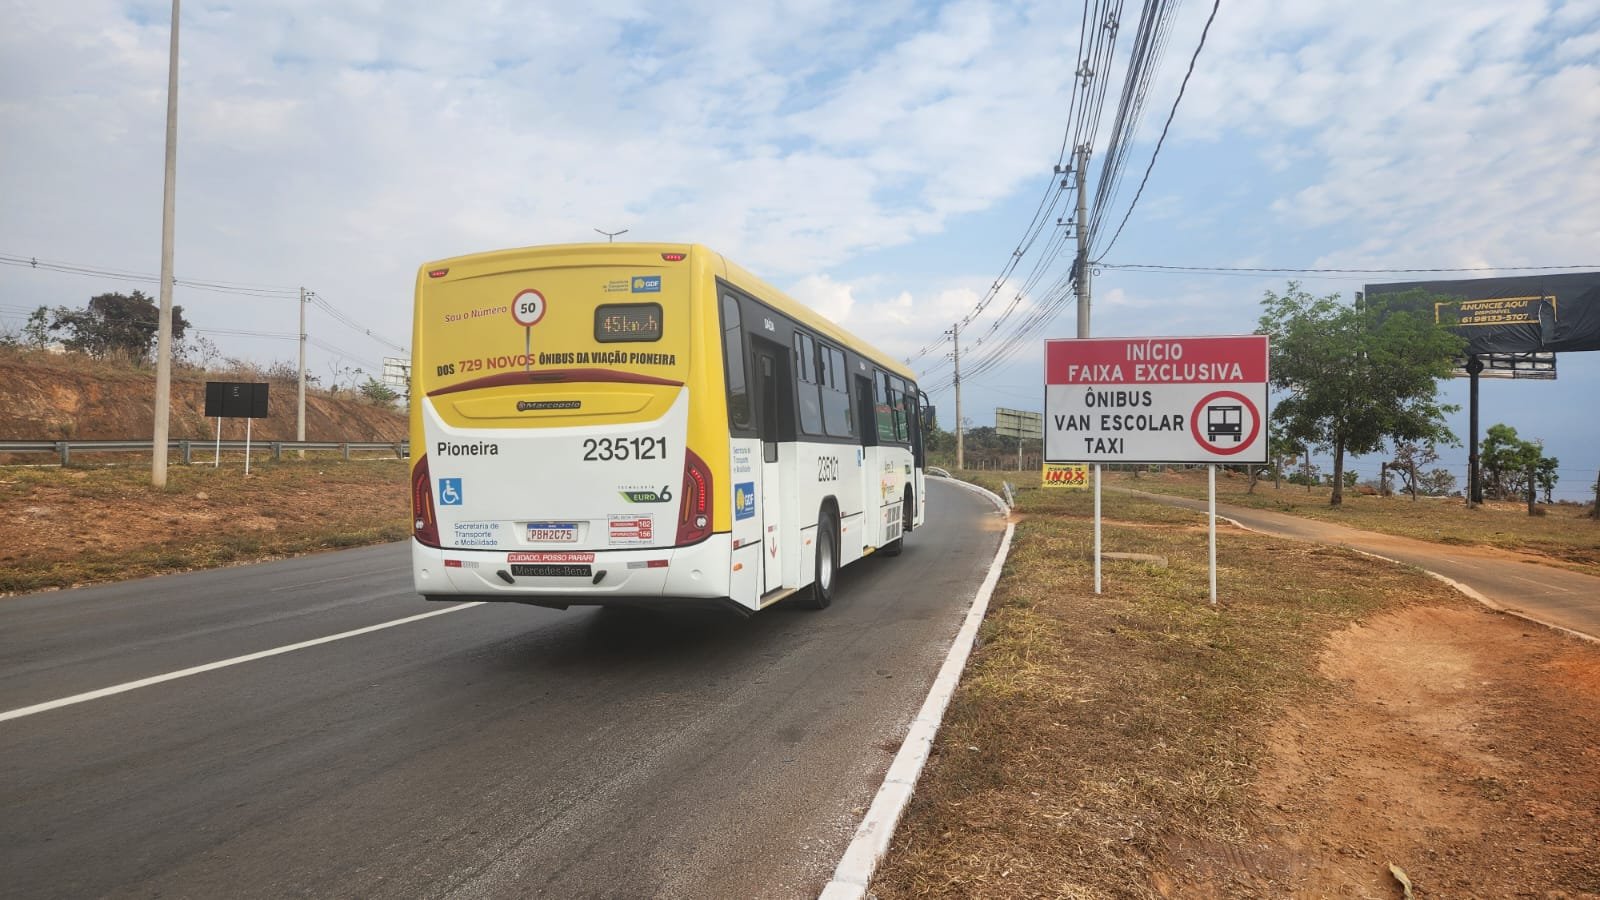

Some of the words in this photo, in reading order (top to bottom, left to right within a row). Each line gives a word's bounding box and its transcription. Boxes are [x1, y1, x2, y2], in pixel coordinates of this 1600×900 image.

[444, 314, 461, 322] Sou
[463, 312, 469, 320] o
[471, 306, 507, 318] Número
[520, 302, 536, 314] 50
[1461, 302, 1502, 311] ANUNCIE
[1126, 340, 1182, 360] INÍCIO
[437, 364, 454, 376] DOS
[458, 359, 482, 372] 729
[487, 354, 536, 370] NOVOS
[539, 352, 575, 365] ÔNIBUS
[576, 352, 589, 364] DA
[592, 350, 628, 366] VIAÇÃO
[630, 352, 676, 366] PIONEIRA
[1068, 365, 1124, 382] FAIXA
[1135, 363, 1244, 381] EXCLUSIVA
[526, 401, 580, 409] Marcopolo
[1085, 386, 1152, 408] ÔNIBUS
[1054, 414, 1090, 431] VAN
[1101, 414, 1184, 431] ESCOLAR
[437, 441, 498, 456] Pioneira
[583, 436, 667, 461] 235121
[1084, 438, 1124, 454] TAXI
[1046, 470, 1085, 480] INOX
[660, 485, 672, 502] 6
[744, 494, 754, 506] GDF
[531, 530, 572, 540] PBH2C75
[516, 566, 588, 576] Mercedes-Benz
